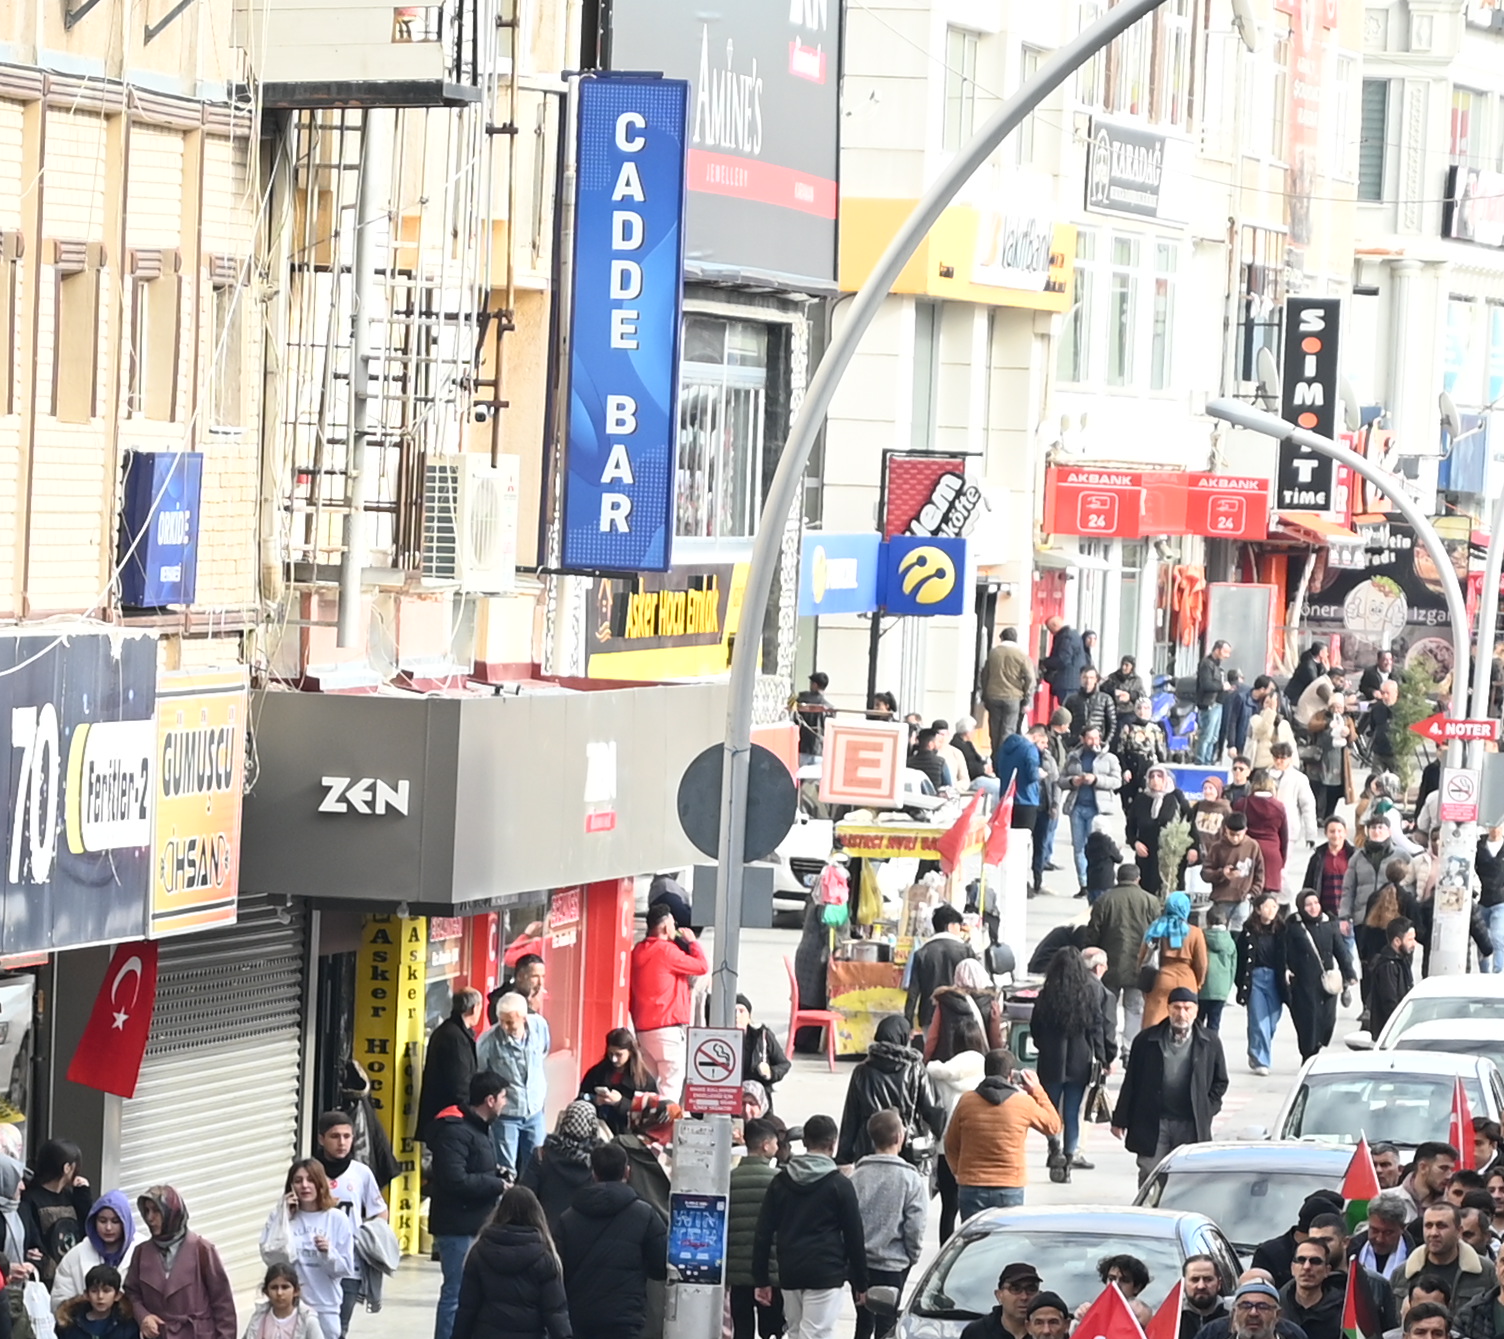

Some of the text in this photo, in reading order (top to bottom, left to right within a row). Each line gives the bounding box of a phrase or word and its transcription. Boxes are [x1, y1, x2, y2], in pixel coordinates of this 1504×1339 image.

[1067, 473, 1132, 486] AKBANK
[1198, 478, 1259, 490] AKBANK
[1088, 514, 1106, 528] 24
[1217, 517, 1235, 530] 24
[1429, 722, 1491, 736] 4. NOTER
[10, 705, 60, 886] 70
[319, 777, 410, 815] ZEN
